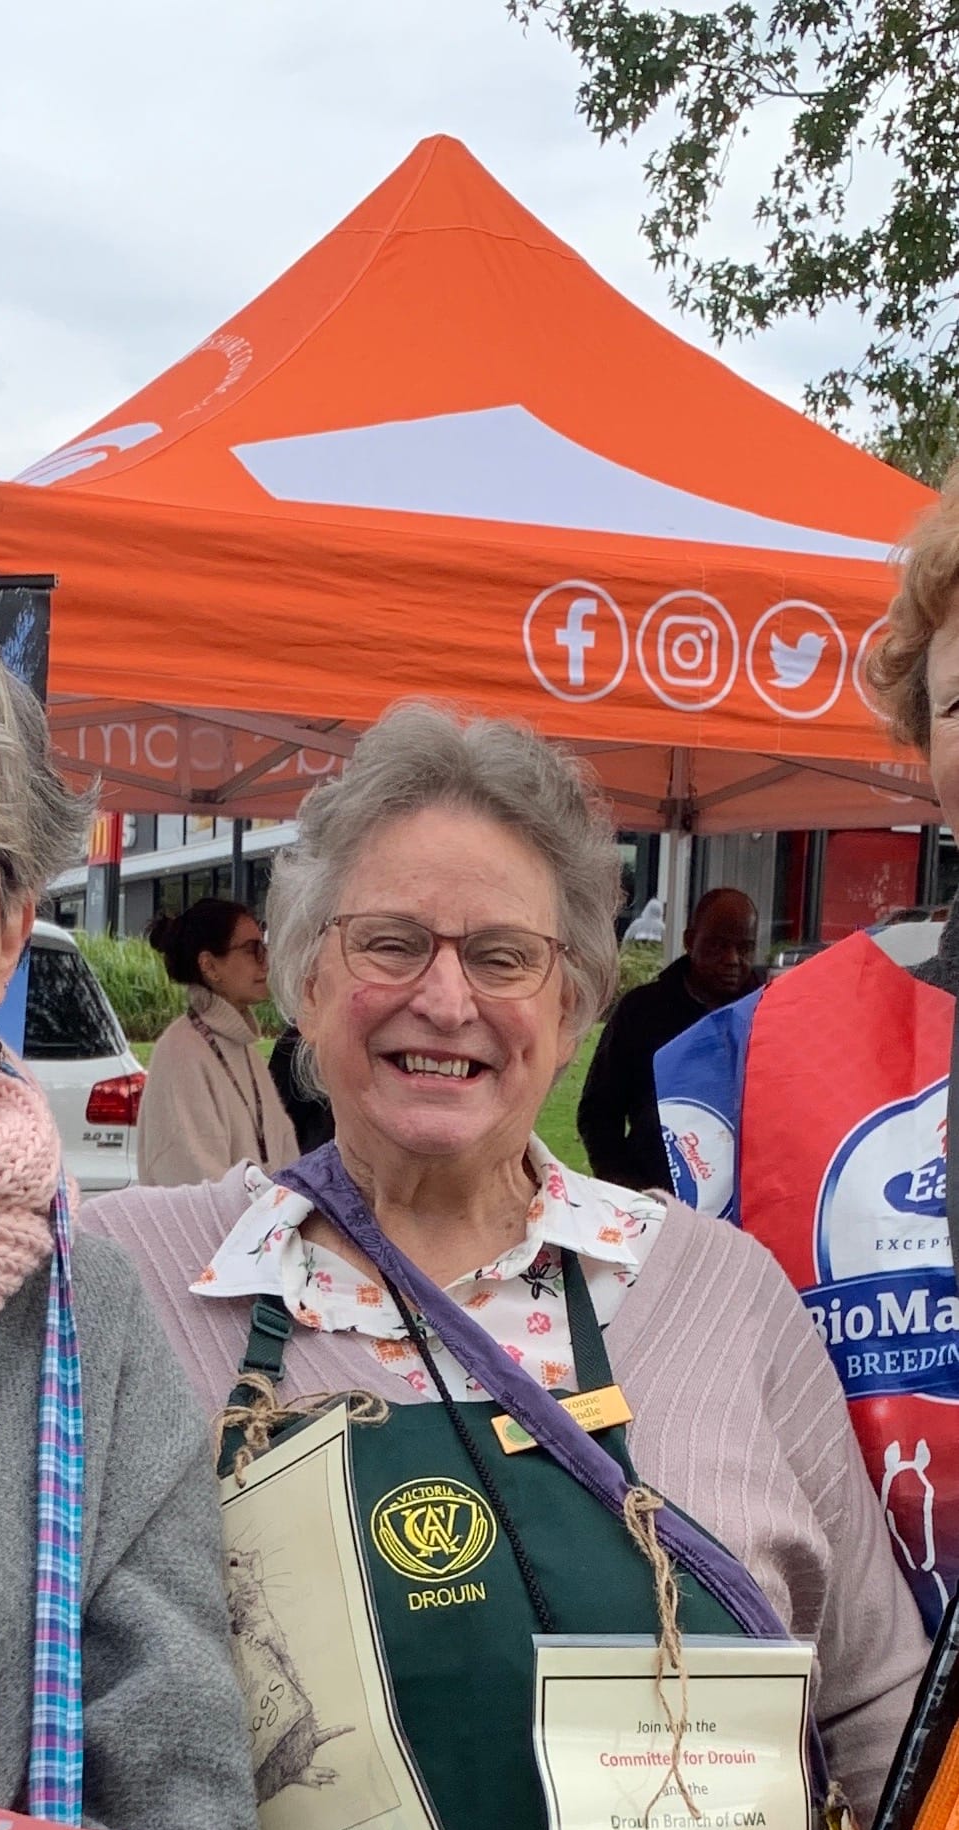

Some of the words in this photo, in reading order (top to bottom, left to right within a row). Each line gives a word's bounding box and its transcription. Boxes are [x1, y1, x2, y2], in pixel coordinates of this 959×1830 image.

[564, 1396, 600, 1410] vonne
[397, 1485, 455, 1504] VICTORIA
[408, 1582, 486, 1610] DROUIN
[636, 1720, 661, 1733] Join
[665, 1720, 692, 1732] wih
[696, 1720, 717, 1732] the
[600, 1751, 679, 1766] Committe
[683, 1750, 704, 1765] for
[708, 1750, 756, 1765] Drouin
[688, 1782, 709, 1795] the
[611, 1814, 659, 1830] Droun
[663, 1813, 711, 1829] Branch
[715, 1812, 730, 1827] of
[733, 1811, 766, 1826] CWA
